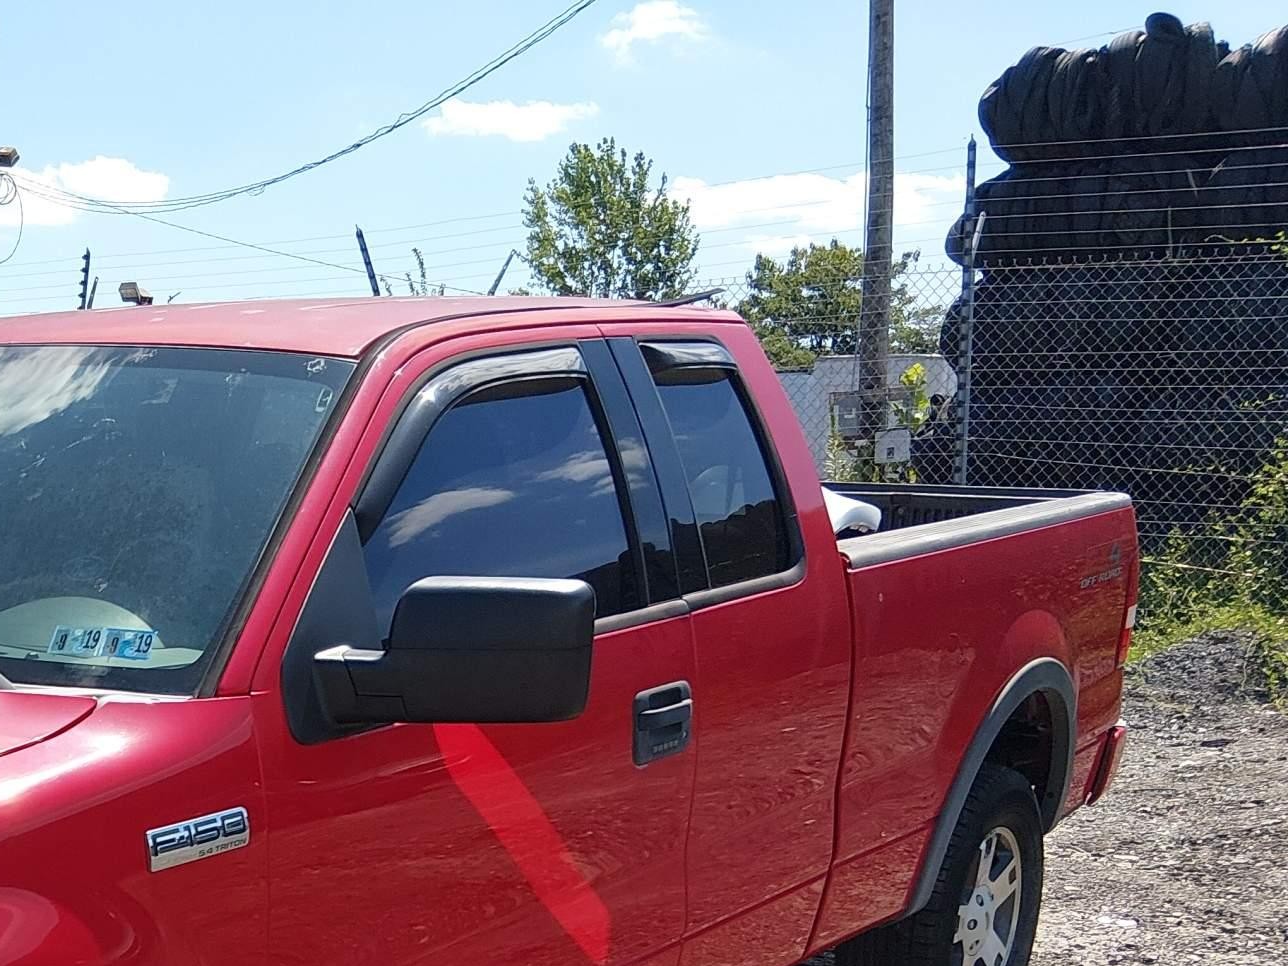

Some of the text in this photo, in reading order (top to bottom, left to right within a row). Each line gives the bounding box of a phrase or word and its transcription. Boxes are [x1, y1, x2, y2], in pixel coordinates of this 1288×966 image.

[82, 630, 101, 650] 19
[134, 634, 153, 654] 19
[215, 837, 248, 852] TRITON
